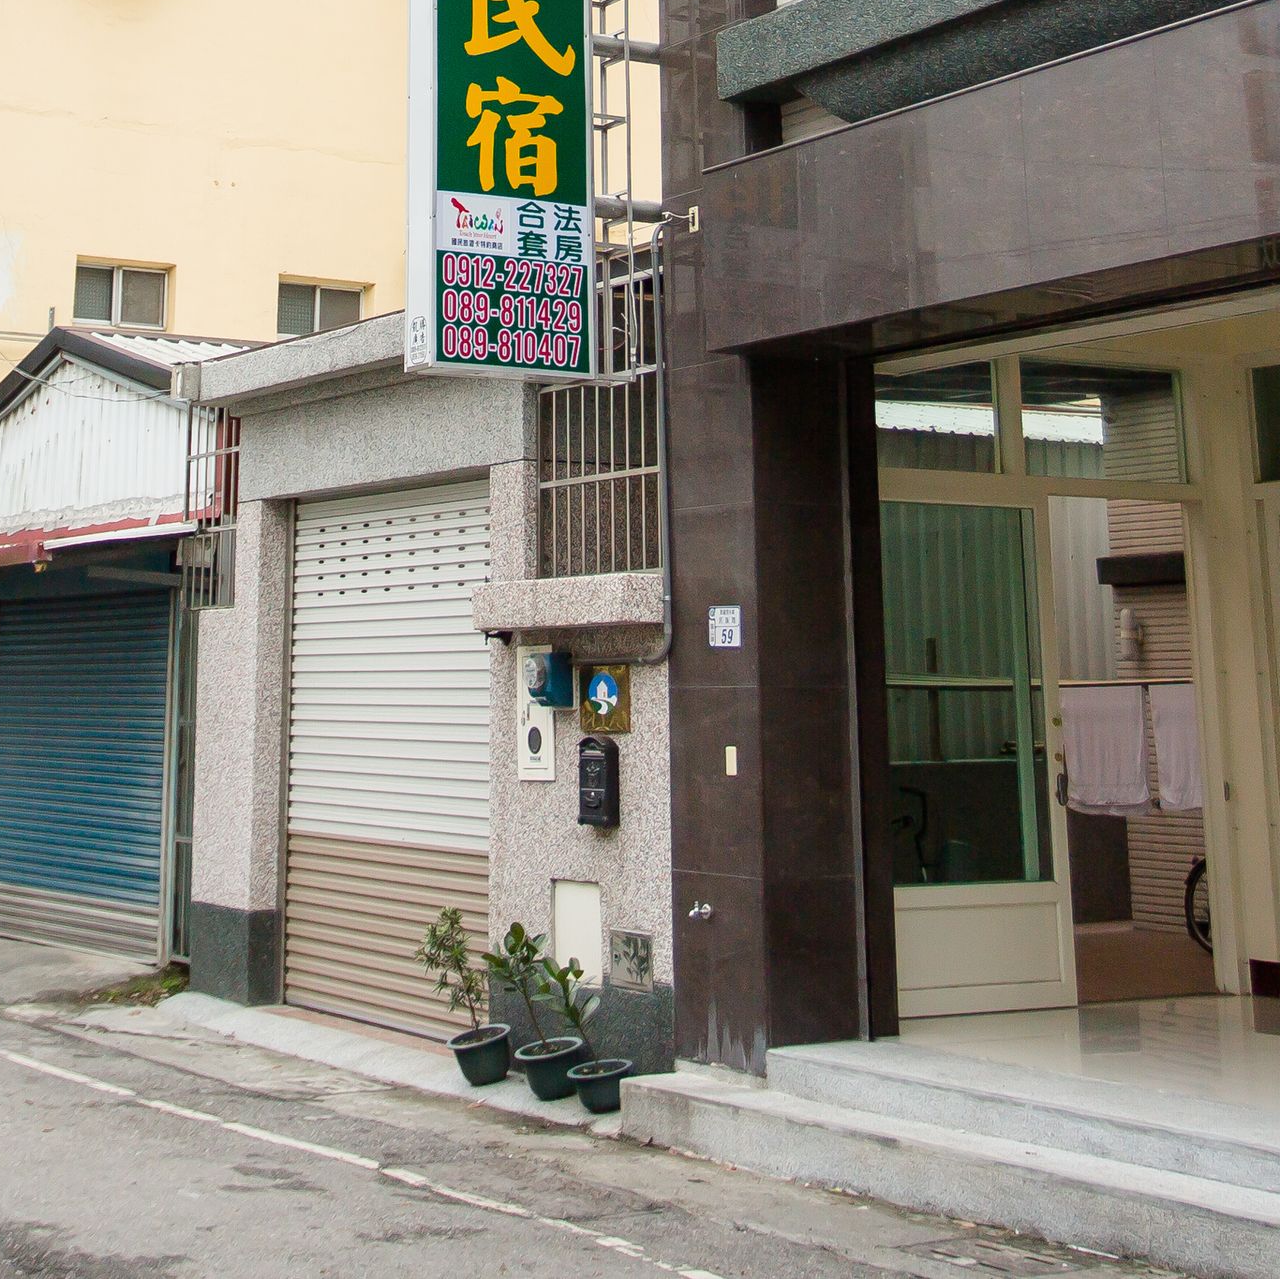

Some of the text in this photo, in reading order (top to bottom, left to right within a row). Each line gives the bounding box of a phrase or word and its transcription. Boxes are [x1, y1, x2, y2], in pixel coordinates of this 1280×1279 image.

[516, 201, 582, 234] 合法
[517, 230, 583, 263] 套房
[442, 253, 584, 298] 0912-227327
[442, 288, 582, 334] 089-811429
[442, 323, 581, 368] 089-810407
[721, 628, 734, 644] 59
